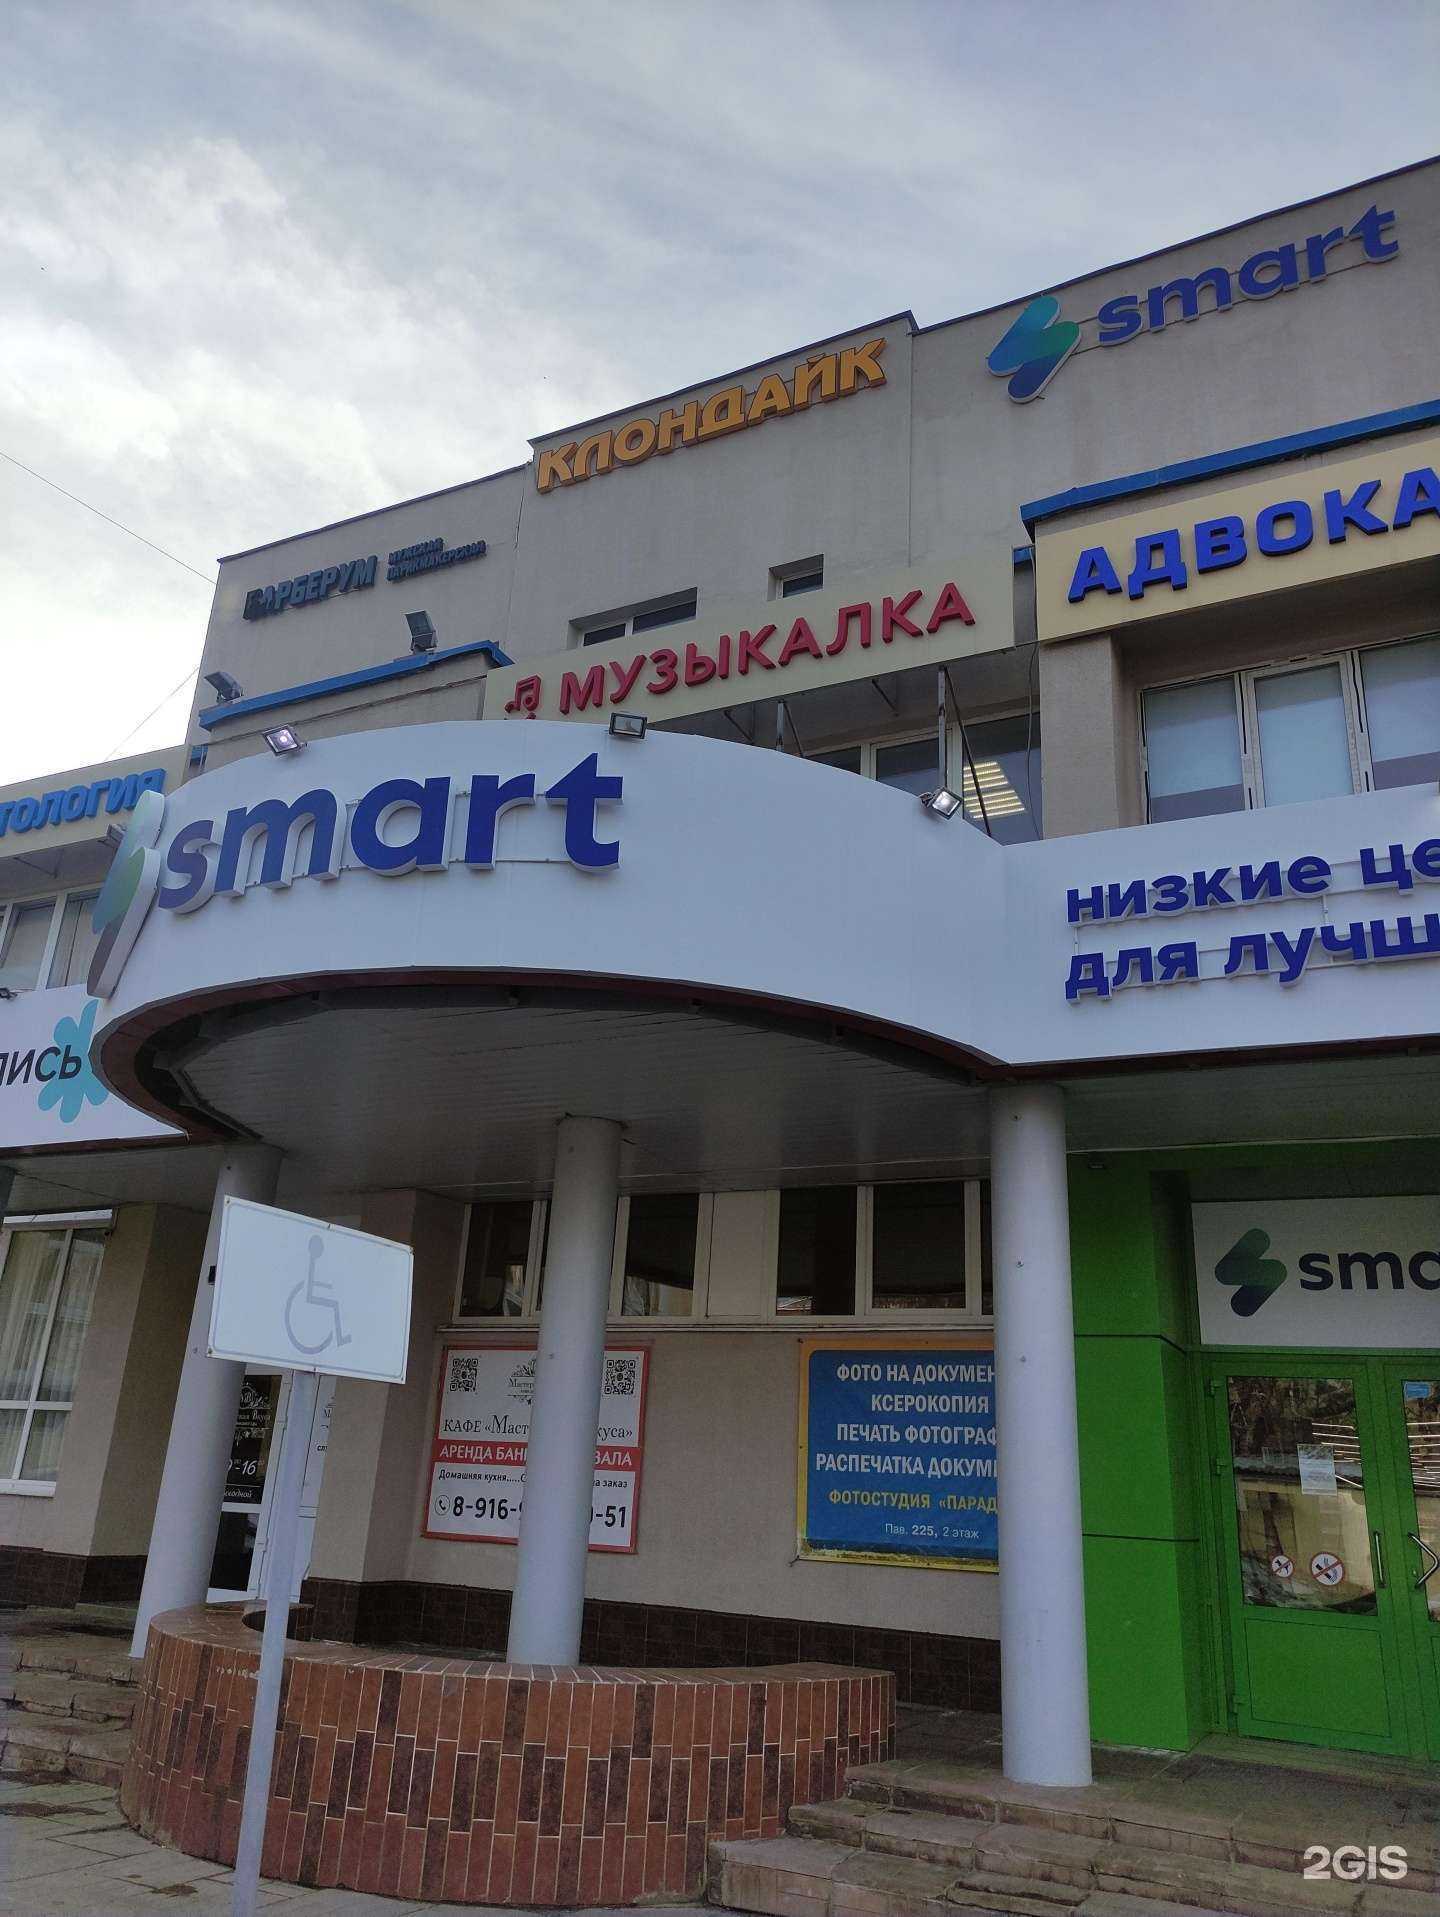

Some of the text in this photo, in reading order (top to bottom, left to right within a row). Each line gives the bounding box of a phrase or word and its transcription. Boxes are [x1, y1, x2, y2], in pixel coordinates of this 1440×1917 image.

[1097, 203, 1399, 347] smart
[537, 337, 887, 493] КЛОНДАЙК
[1068, 467, 1440, 603] АДВОКА
[559, 582, 976, 715] МУЗЫКАЛКА
[158, 752, 623, 913] smart
[1066, 855, 1332, 926] низкие
[1064, 913, 1440, 1003] для лучш
[836, 1363, 882, 1382] ФОТО
[886, 1364, 910, 1383] НА
[871, 1393, 989, 1414] КСЕРОКОПИЯ
[443, 1418, 482, 1434] КАФЕ
[836, 1423, 901, 1443] ПЕЧАТЬ
[439, 1443, 493, 1463] АРЕНДА
[816, 1452, 925, 1475] РАСПЕЧАТКА
[438, 1468, 482, 1482] Домашняя
[602, 1480, 628, 1489] заказ
[828, 1488, 931, 1510] ФОТОСТУДИЯ
[885, 1523, 908, 1536] Пав.
[912, 1525, 938, 1538] 225,
[943, 1526, 950, 1538] 2
